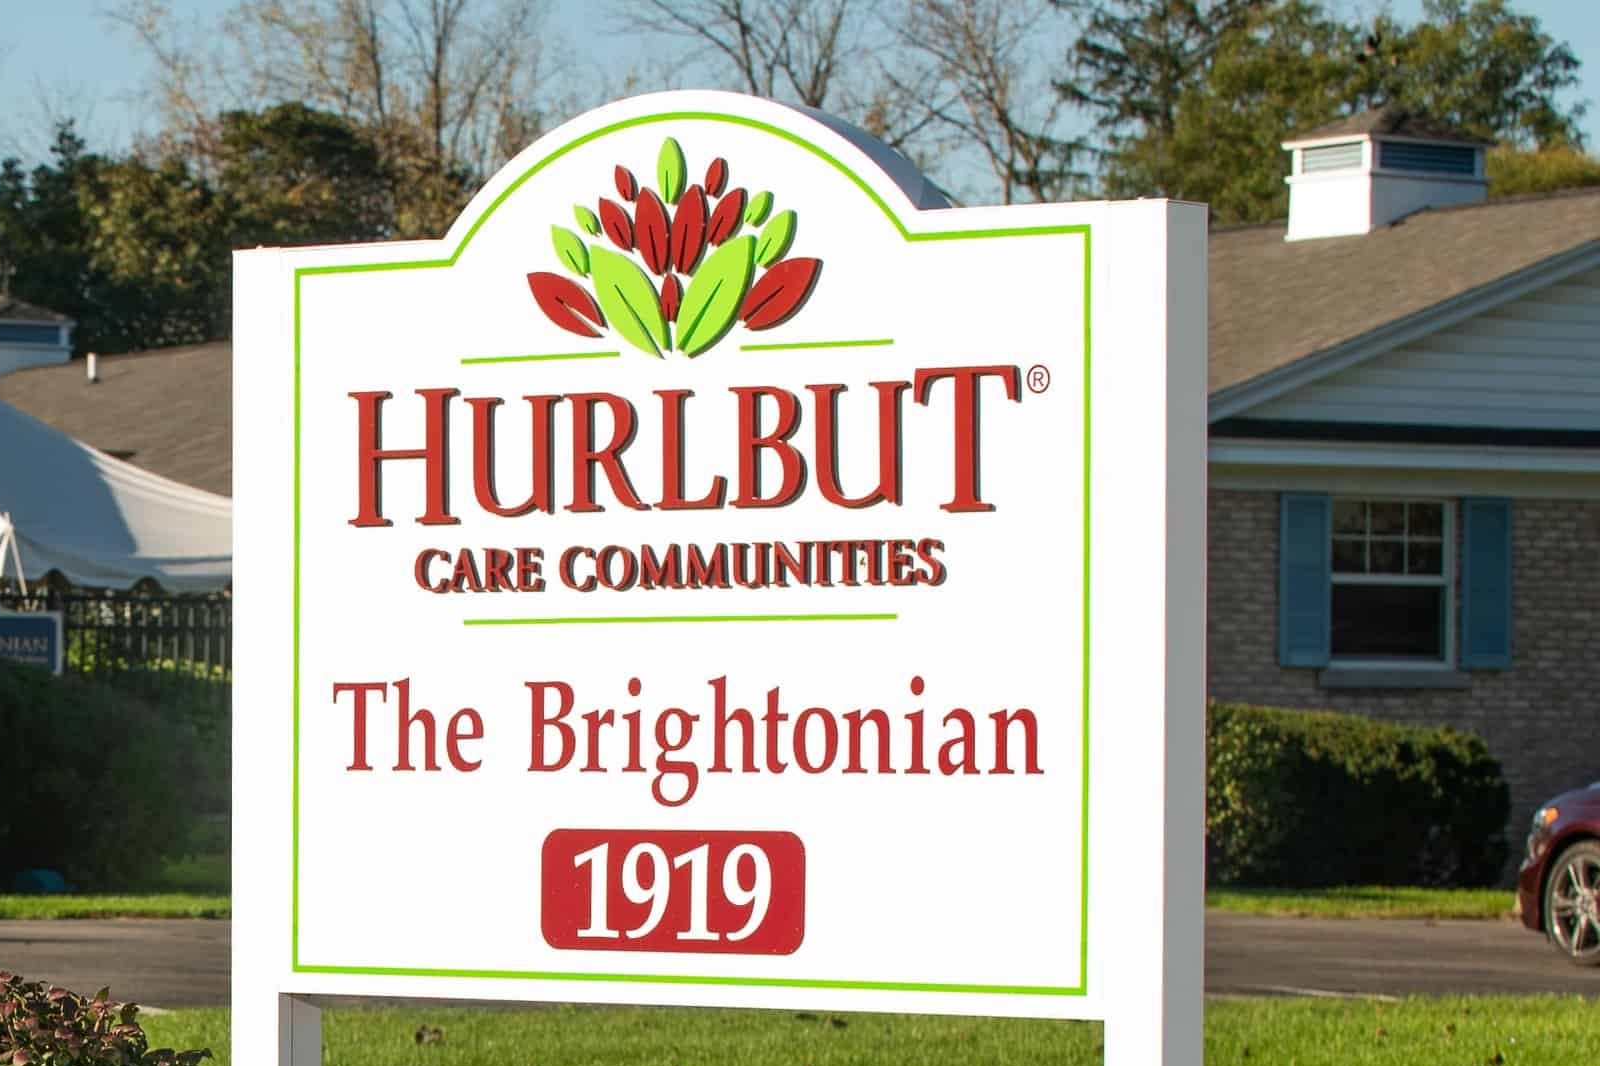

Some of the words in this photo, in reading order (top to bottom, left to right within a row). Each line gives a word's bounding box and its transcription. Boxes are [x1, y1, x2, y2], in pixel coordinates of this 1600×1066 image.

[414, 547, 547, 594] CARE
[558, 537, 948, 593] COMMUNITIES
[332, 676, 485, 773] The
[524, 674, 1045, 808] Brightonian
[574, 842, 772, 941] 1919
